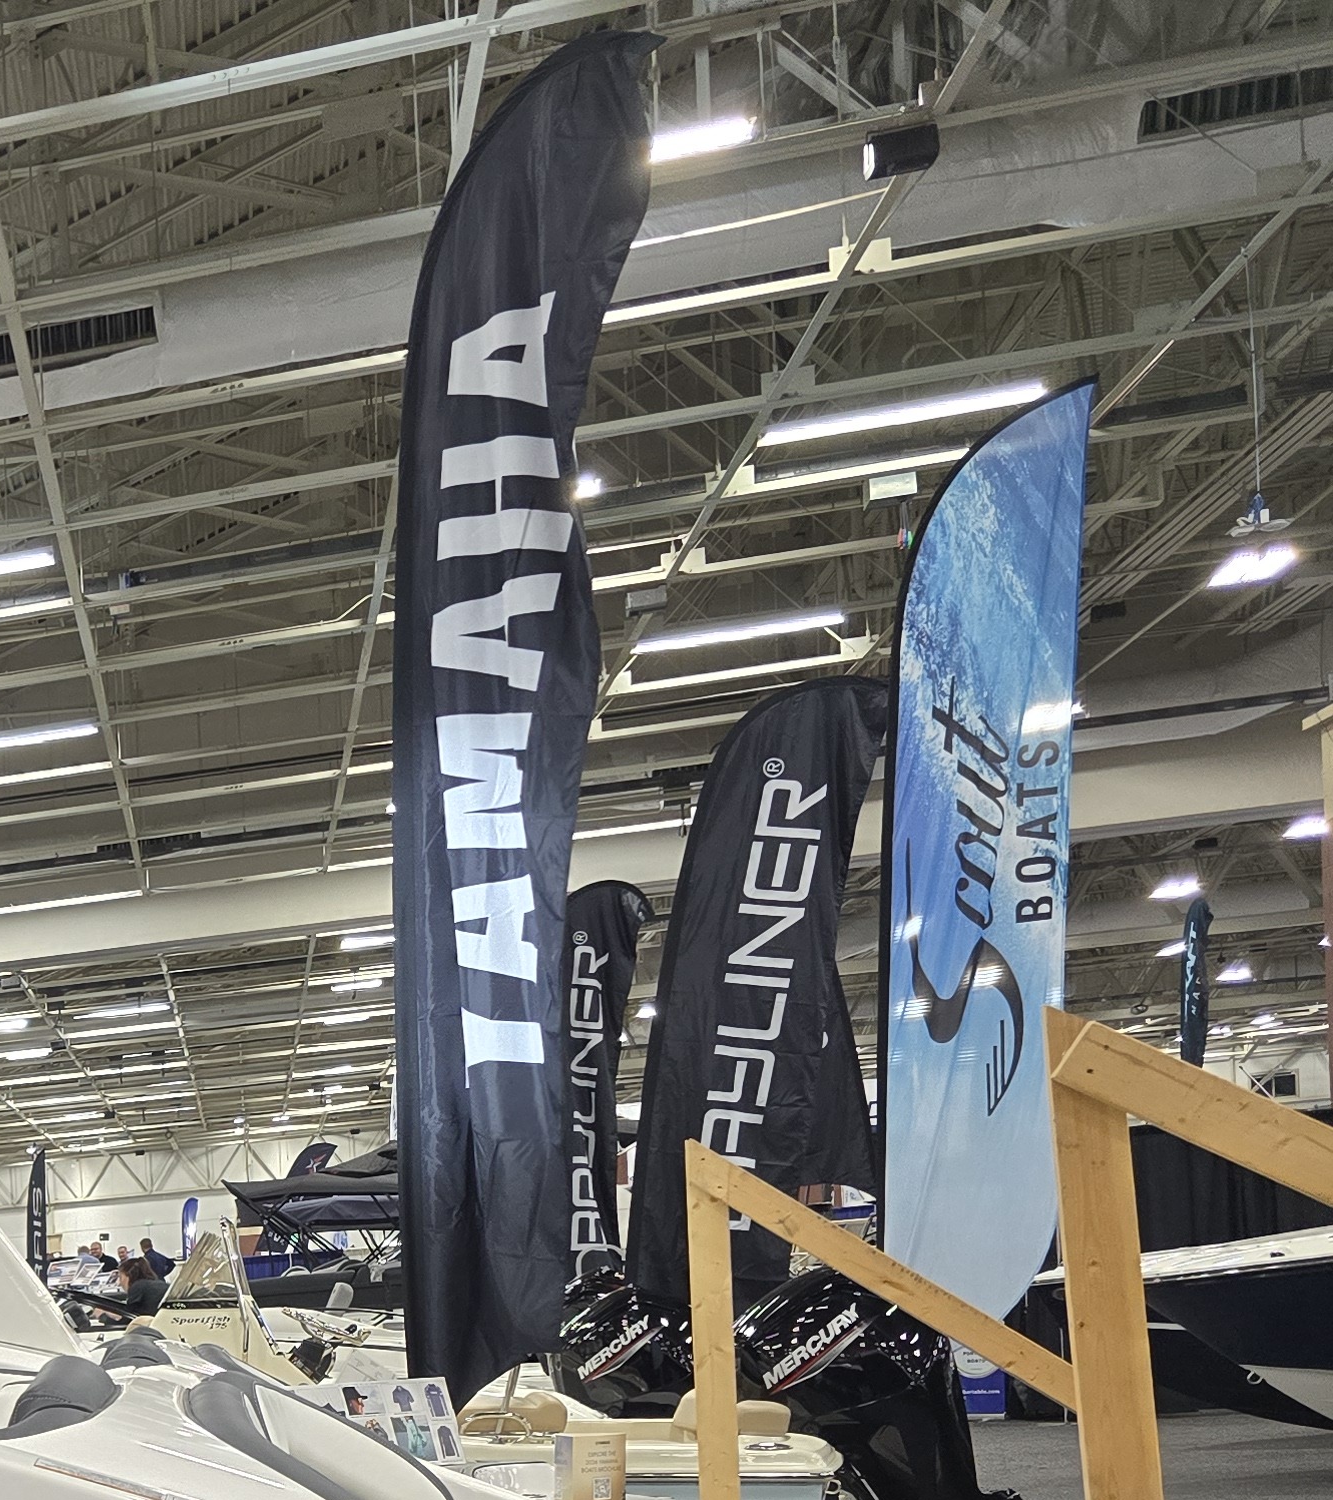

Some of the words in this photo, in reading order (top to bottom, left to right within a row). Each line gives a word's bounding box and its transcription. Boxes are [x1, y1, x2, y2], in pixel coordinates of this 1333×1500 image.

[1014, 740, 1059, 923] BOATS
[905, 675, 1025, 1116] Scout
[171, 1315, 231, 1325] Sportfish
[576, 1314, 652, 1382] MERCURY
[761, 1301, 862, 1392] MERCURY
